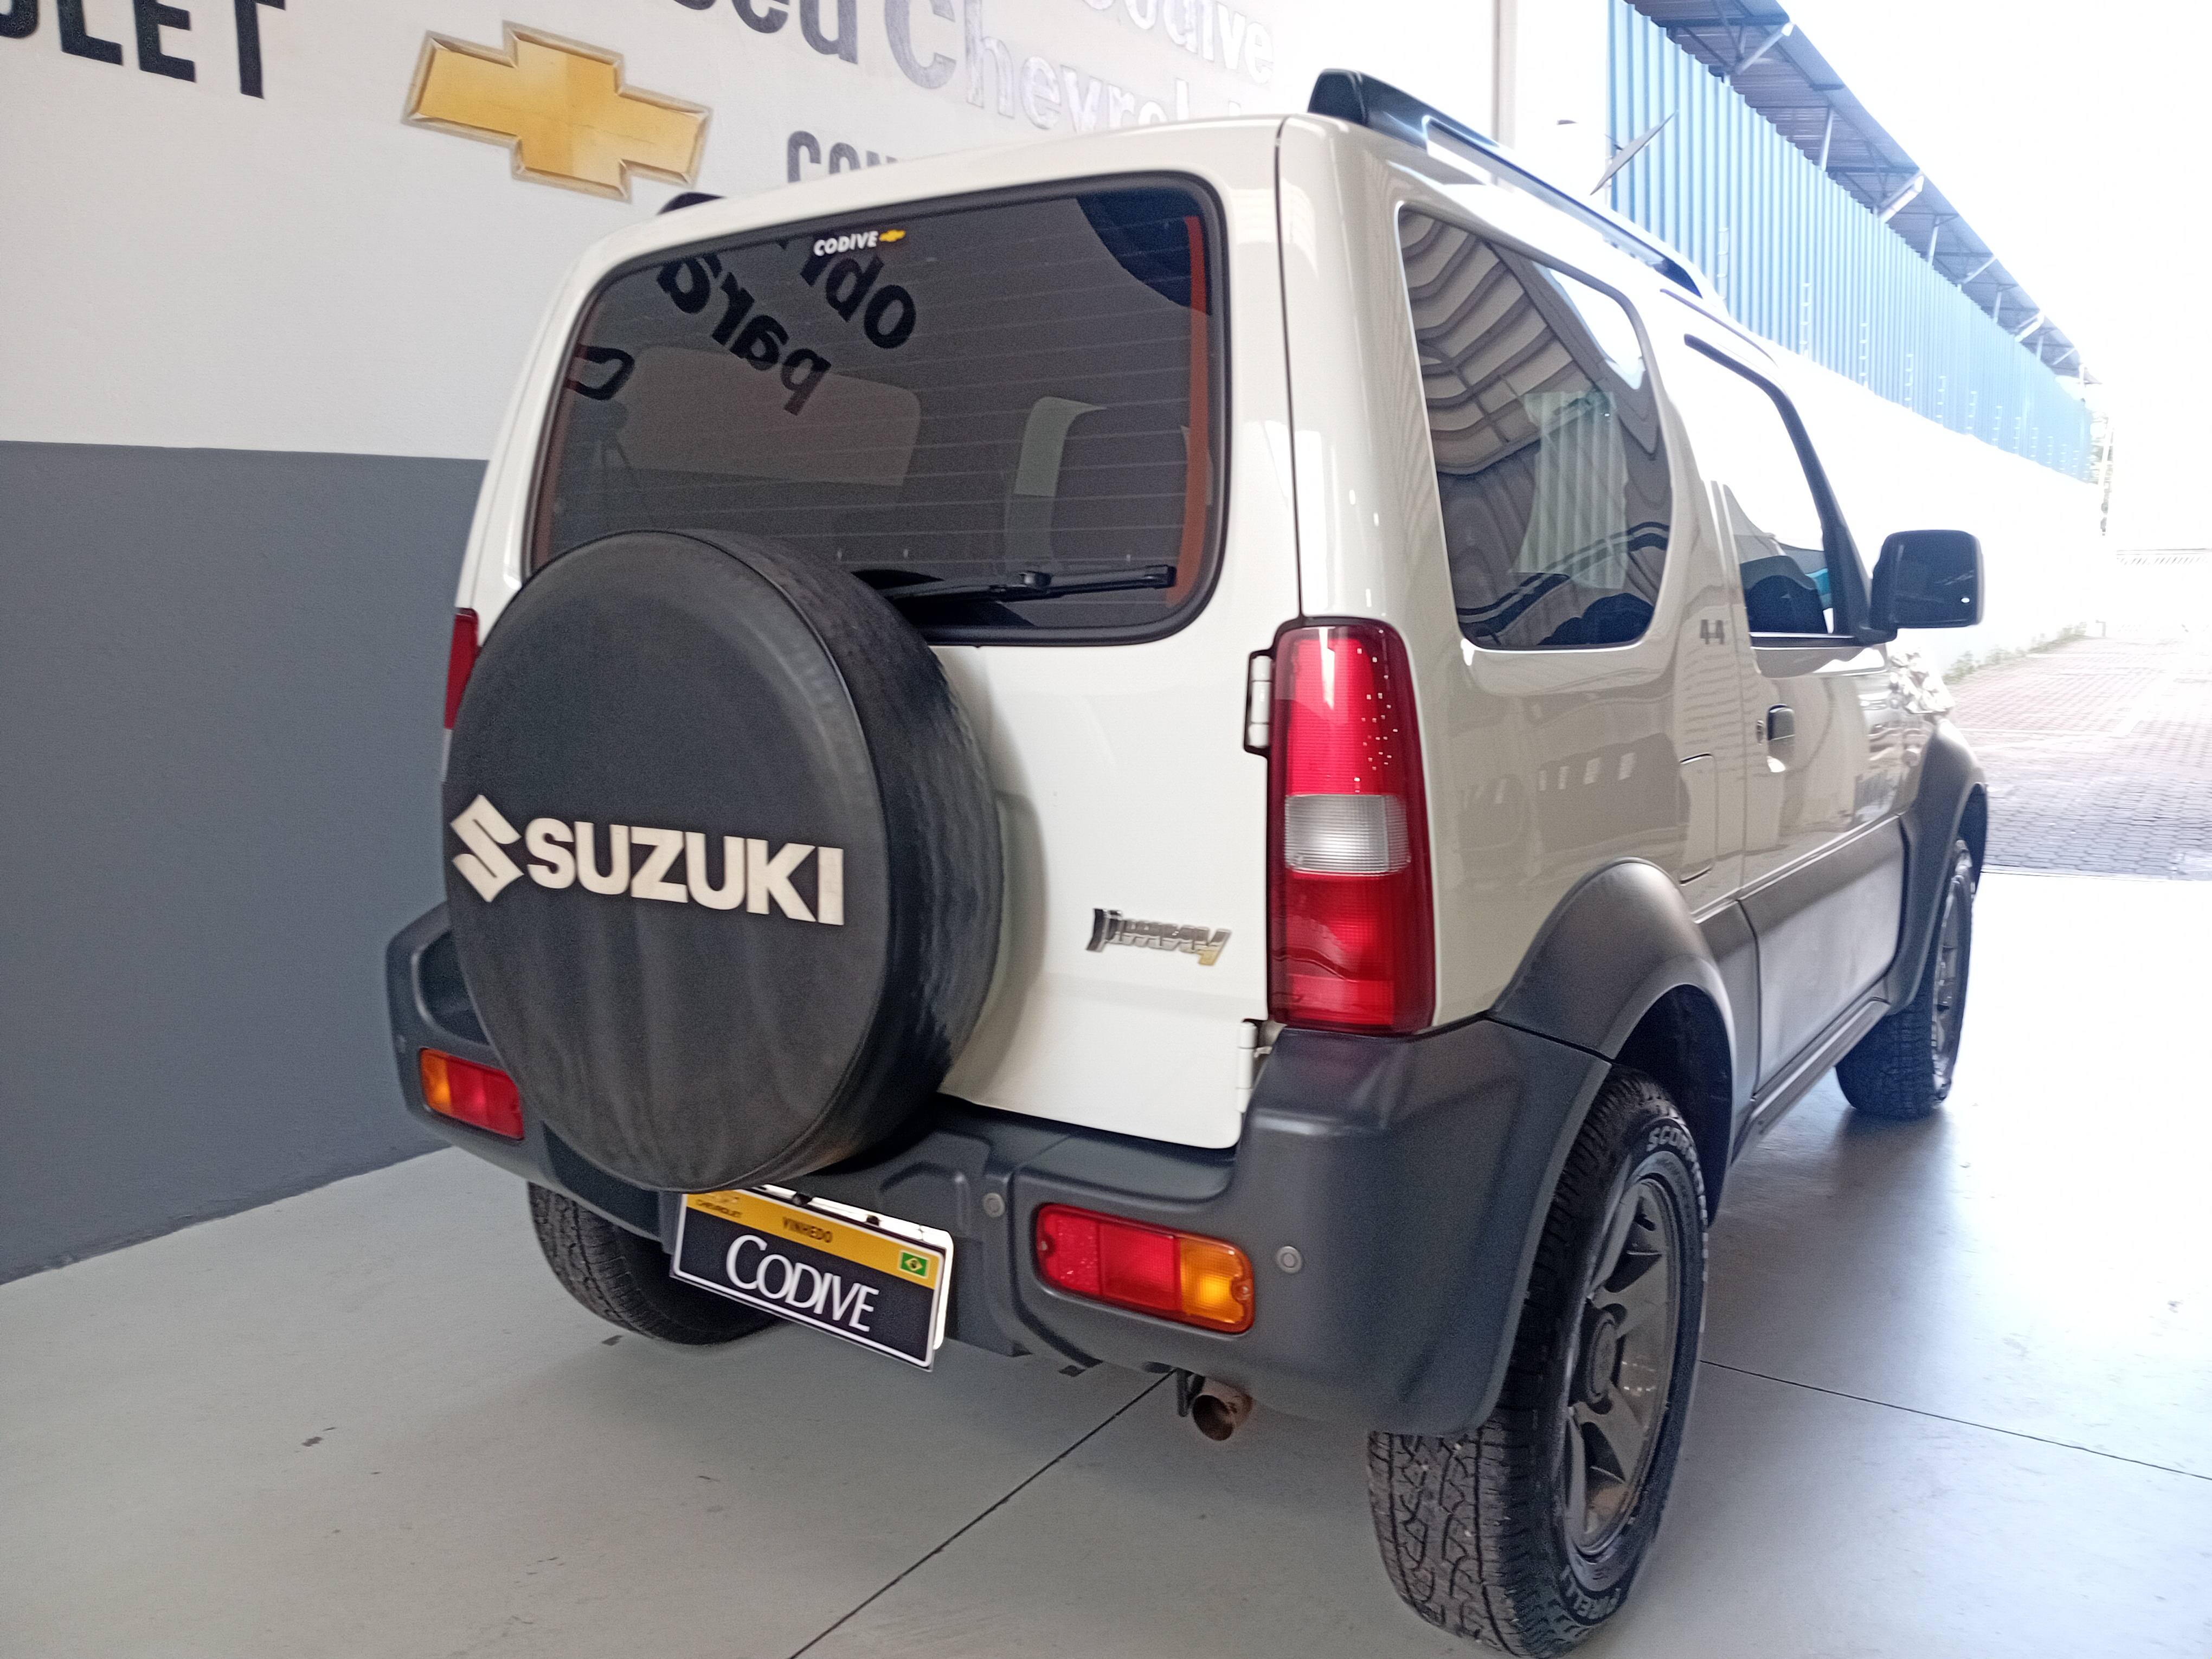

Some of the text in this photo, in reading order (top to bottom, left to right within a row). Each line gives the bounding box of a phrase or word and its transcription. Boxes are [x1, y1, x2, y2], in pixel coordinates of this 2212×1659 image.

[814, 230, 879, 256] CODIVE
[524, 818, 845, 926] SUZUKI
[782, 1216, 833, 1244] VINHEDO
[725, 1234, 879, 1332] CODIVE
